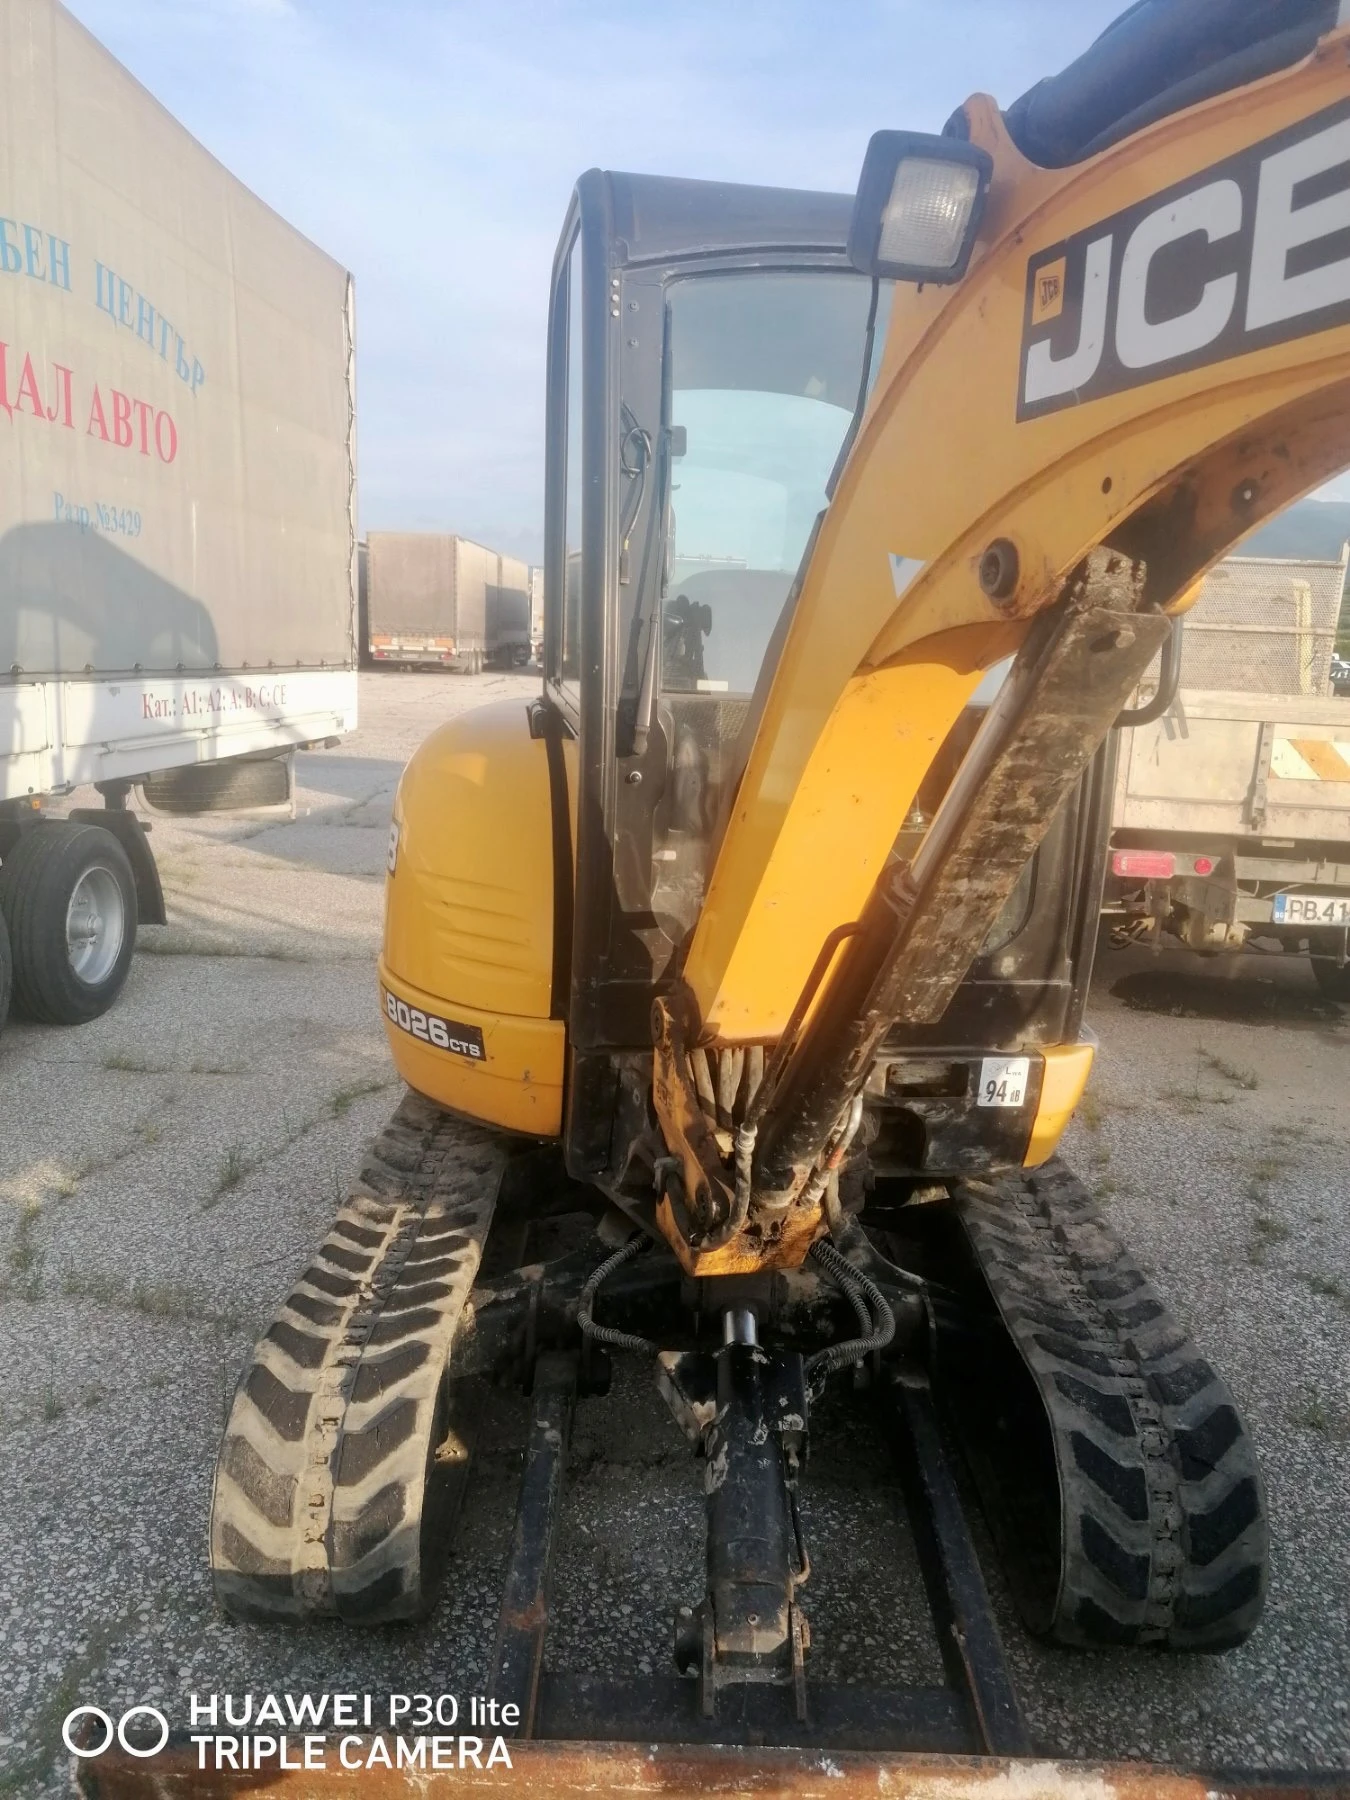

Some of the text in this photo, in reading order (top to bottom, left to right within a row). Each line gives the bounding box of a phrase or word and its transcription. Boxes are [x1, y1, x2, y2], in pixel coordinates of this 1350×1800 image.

[94, 259, 205, 396] ЦЕНТЪР
[86, 384, 178, 464] АВТО
[986, 1080, 1008, 1102] 94
